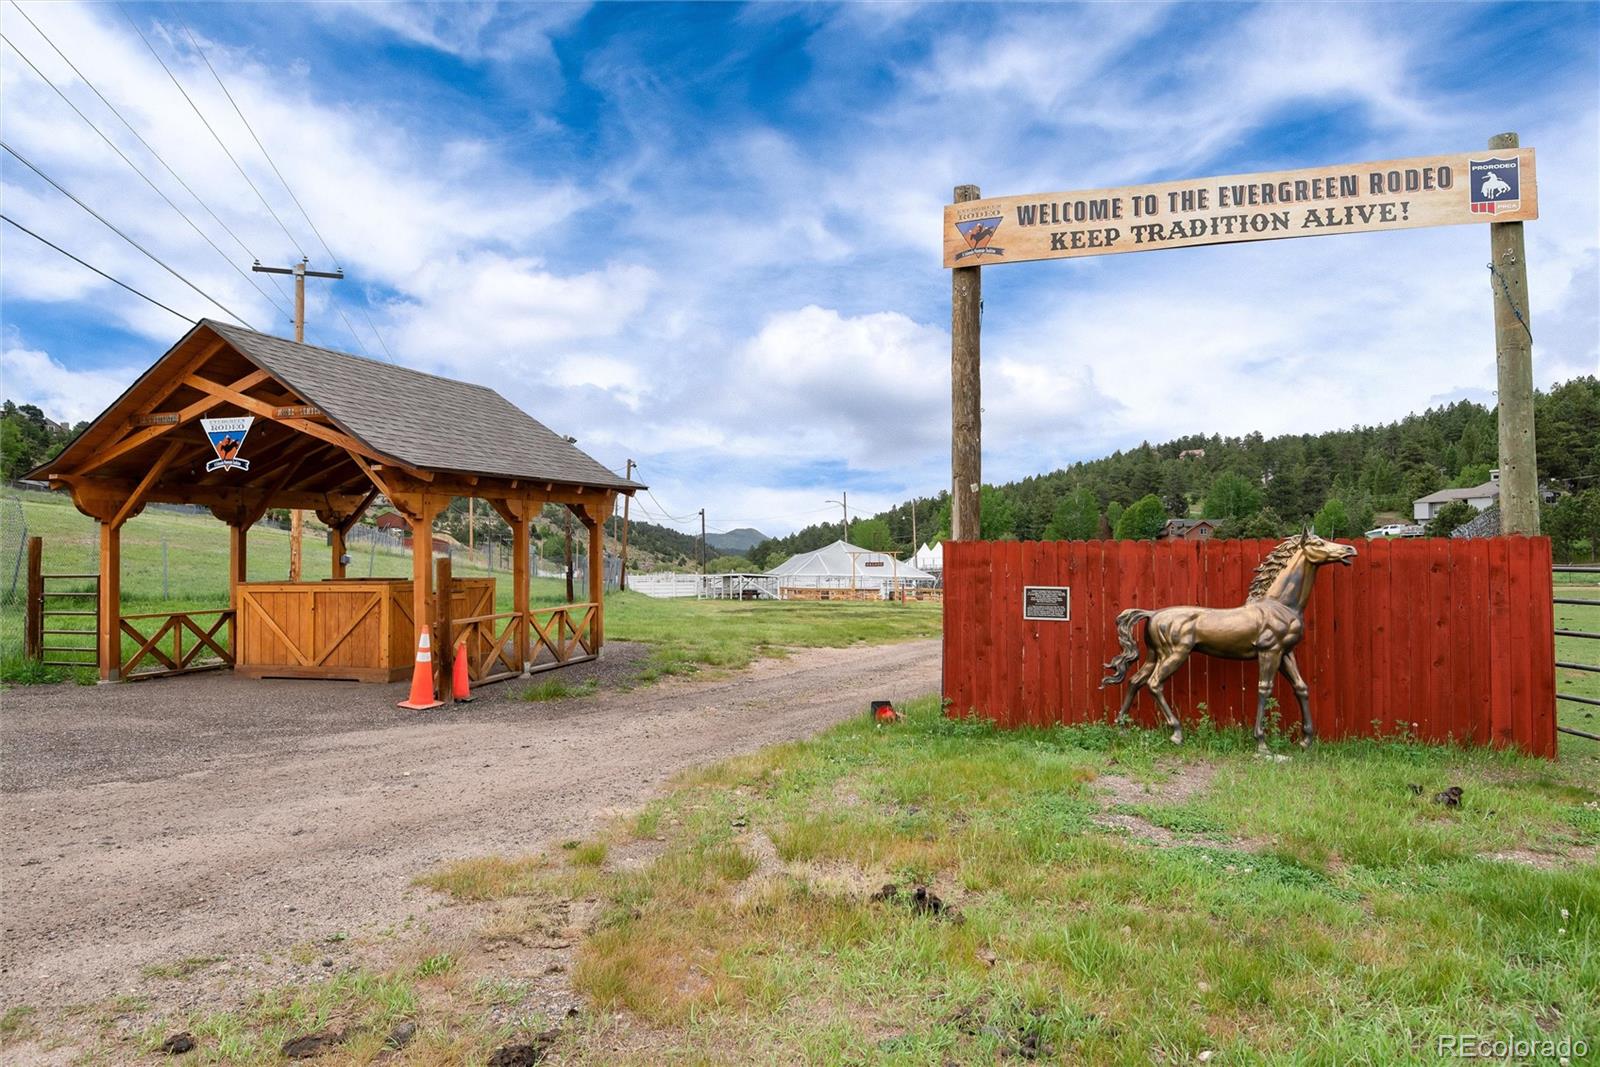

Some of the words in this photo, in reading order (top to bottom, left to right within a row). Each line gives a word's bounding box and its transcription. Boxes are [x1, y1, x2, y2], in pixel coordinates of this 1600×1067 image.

[1471, 163, 1517, 171] PRORODEO
[1016, 197, 1123, 226] WELCOME
[1131, 193, 1159, 218] TO
[1167, 188, 1210, 213] THE
[1218, 174, 1360, 208] EVERGREEN
[1369, 165, 1454, 195] RODEO
[958, 210, 1001, 221] RODEO
[1050, 228, 1121, 251] KEEP
[1130, 211, 1290, 244] TRADITION
[1301, 201, 1411, 229] ALIVE!
